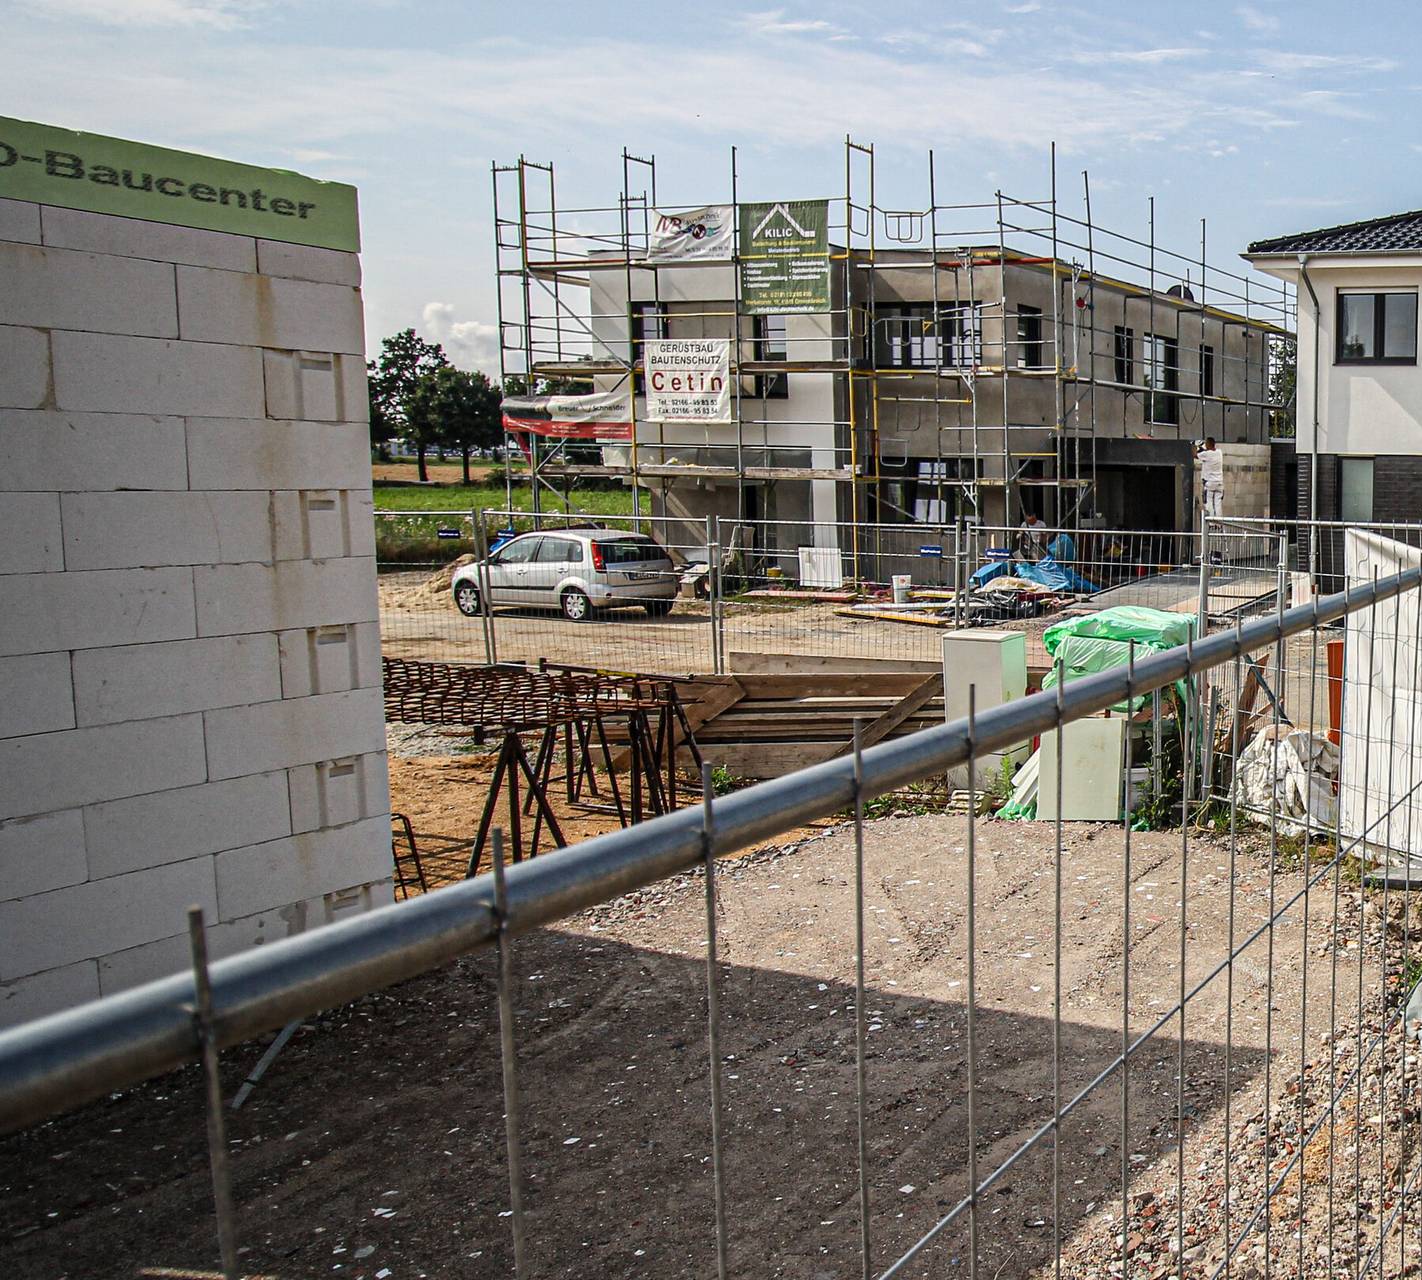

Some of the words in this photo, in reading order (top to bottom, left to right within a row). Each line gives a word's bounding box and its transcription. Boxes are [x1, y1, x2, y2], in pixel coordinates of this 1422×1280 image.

[765, 228, 793, 238] KILIC
[660, 343, 713, 353] GERÜSTBAU
[651, 355, 721, 365] BAUTENSCHUTZ
[652, 372, 722, 391] Cetin
